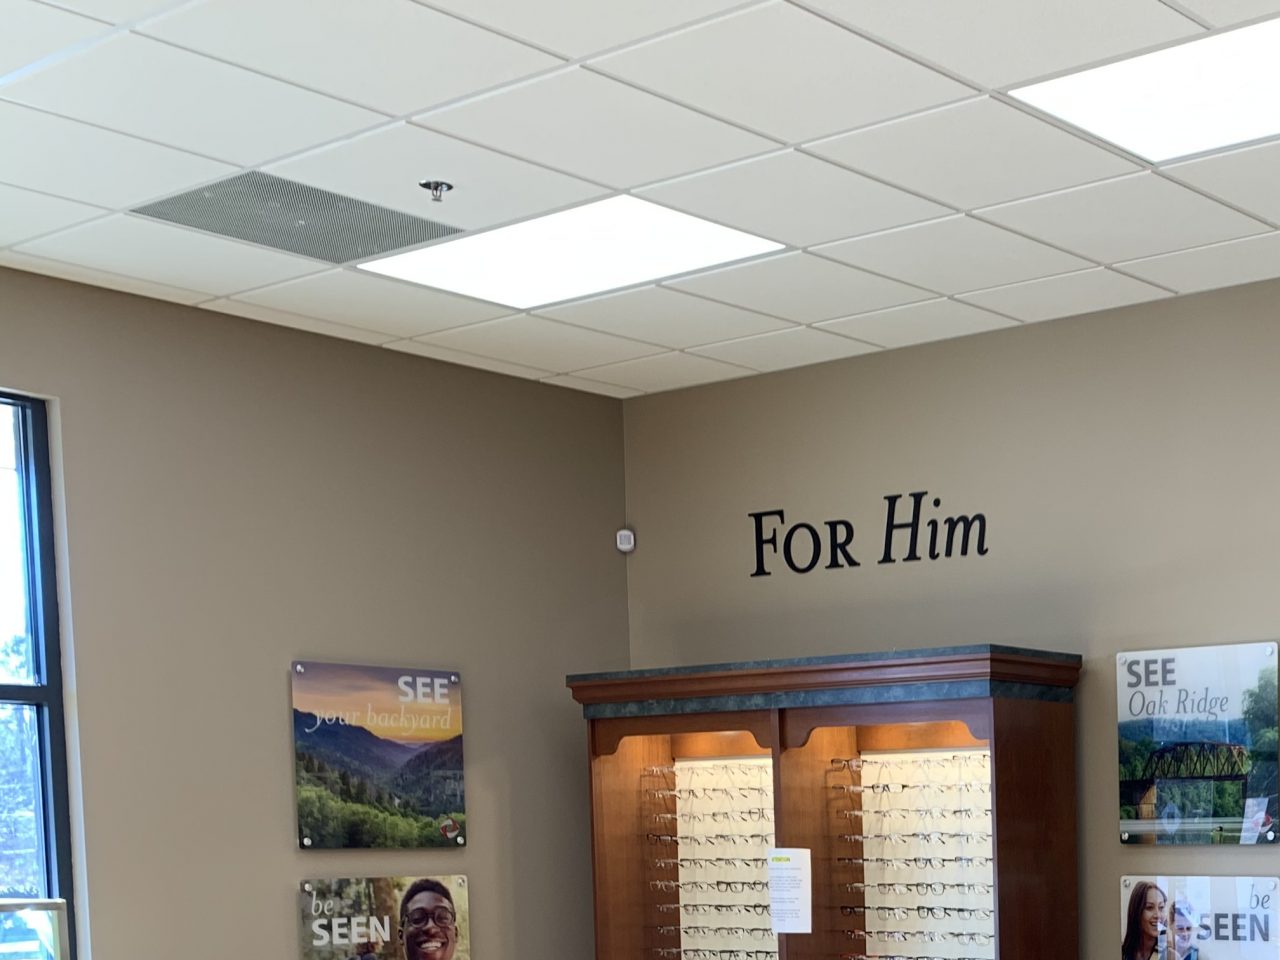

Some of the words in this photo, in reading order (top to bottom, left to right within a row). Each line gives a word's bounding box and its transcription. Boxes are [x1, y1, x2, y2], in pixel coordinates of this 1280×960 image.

[877, 491, 988, 564] Him
[1127, 658, 1176, 687] SEE
[398, 675, 449, 704] SEE
[1129, 690, 1168, 716] Oak
[1176, 688, 1228, 720] Ridge
[305, 709, 360, 733] your
[367, 704, 451, 735] backyard
[312, 891, 333, 915] be
[1250, 884, 1270, 909] be
[312, 915, 390, 946] SEEN
[1196, 913, 1269, 941] SEEN
